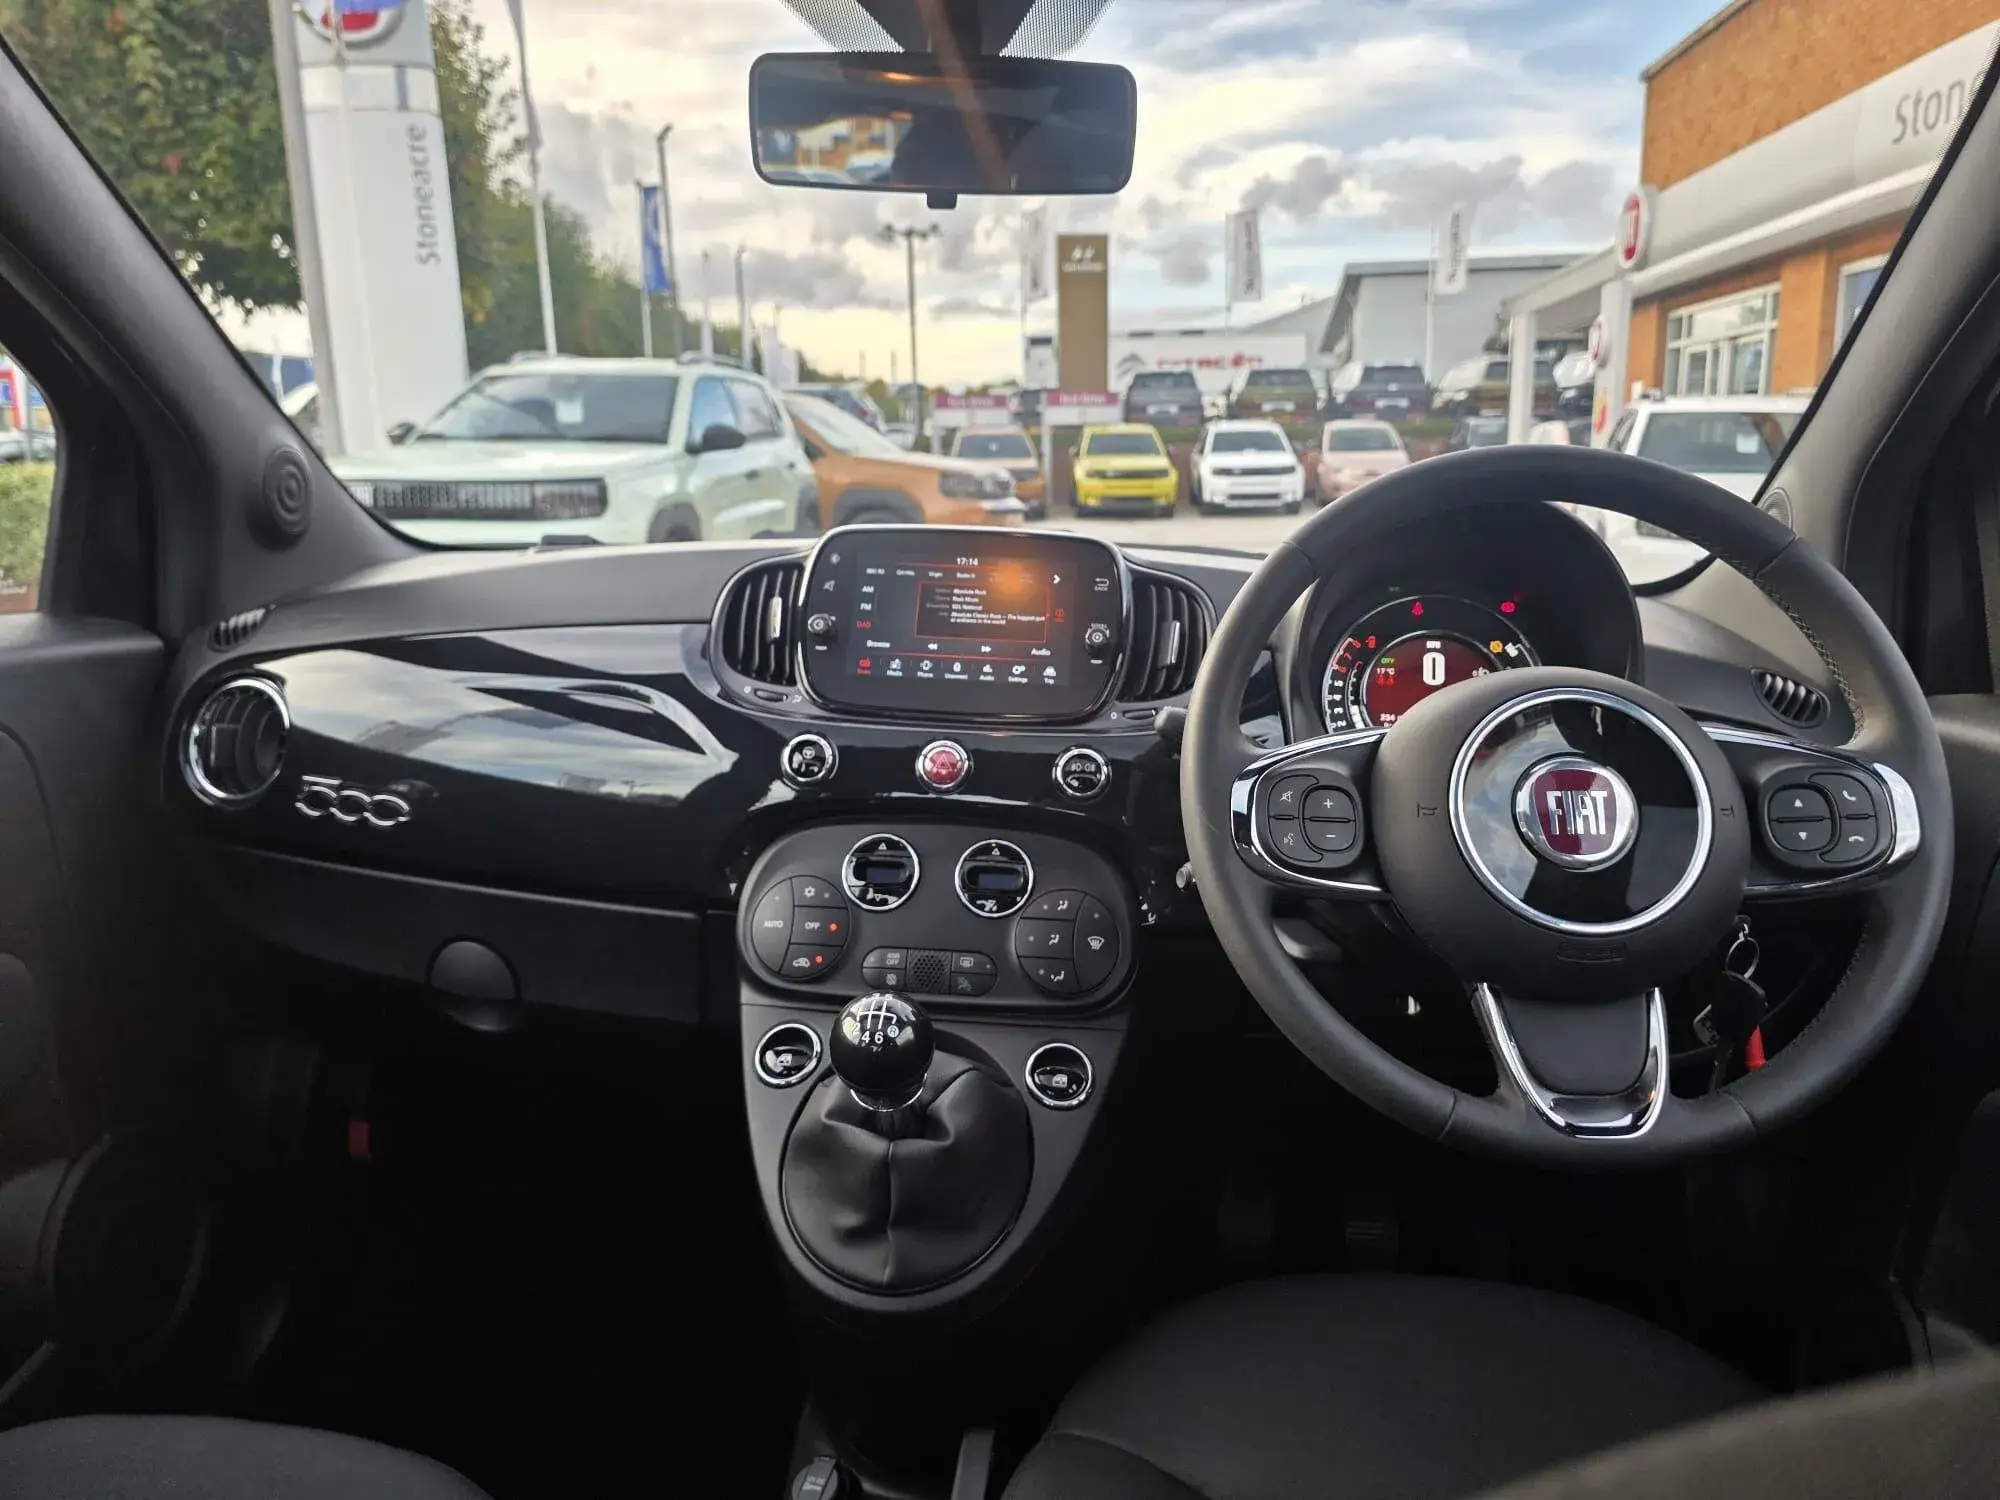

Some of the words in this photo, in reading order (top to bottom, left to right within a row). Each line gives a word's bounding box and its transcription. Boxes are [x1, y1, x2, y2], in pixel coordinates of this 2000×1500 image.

[405, 123, 442, 266] Stoneacre
[957, 557, 979, 566] 17:14
[862, 585, 874, 593] AM
[860, 602, 872, 611] FM
[1031, 647, 1052, 657] Audio
[1422, 652, 1446, 686] 0
[1333, 680, 1344, 688] 5
[295, 775, 410, 827] 500
[1546, 790, 1608, 835] FIAT
[763, 920, 784, 929] AUTO
[804, 921, 821, 930] OFF
[861, 1030, 871, 1044] 4
[874, 1031, 884, 1044] 6
